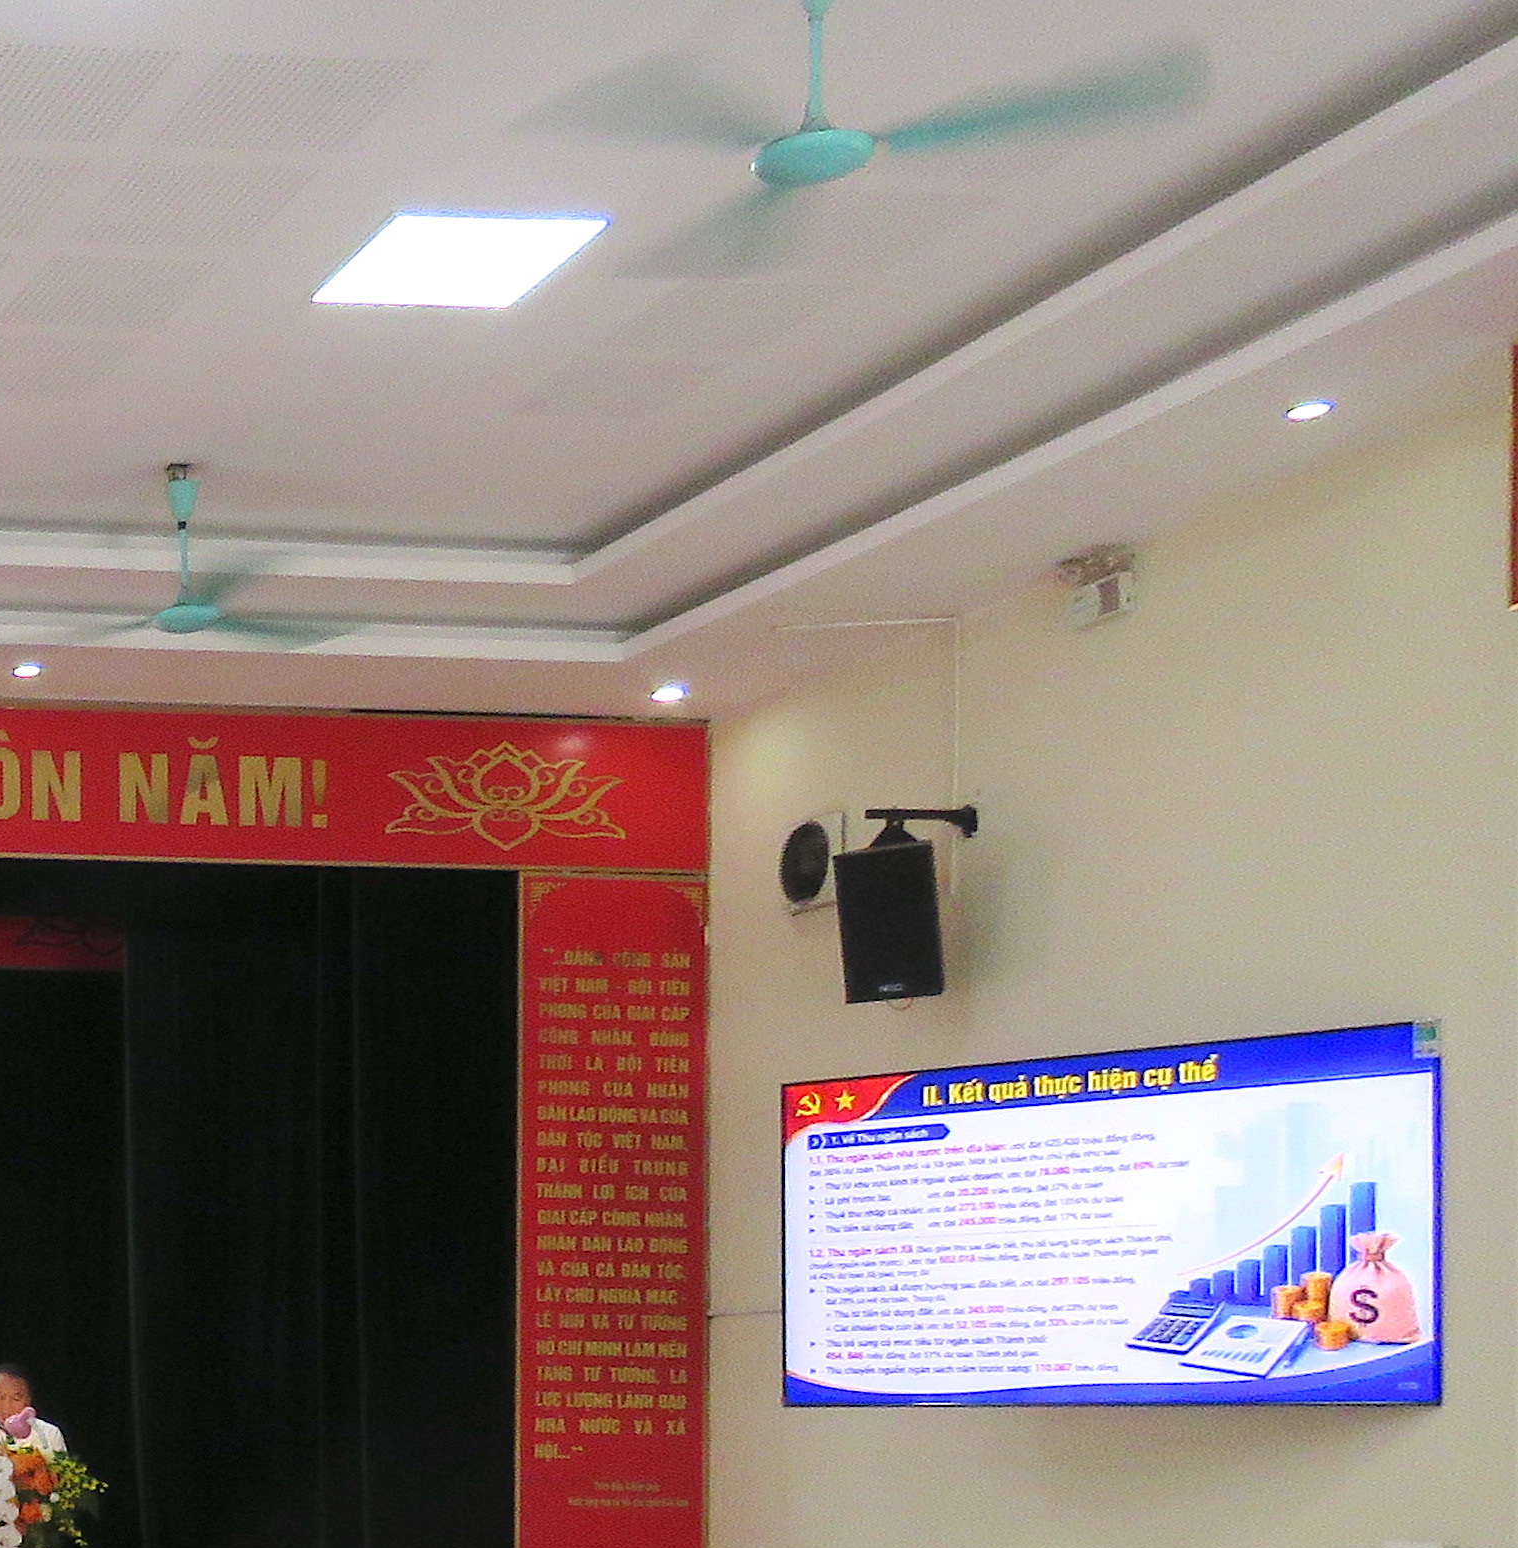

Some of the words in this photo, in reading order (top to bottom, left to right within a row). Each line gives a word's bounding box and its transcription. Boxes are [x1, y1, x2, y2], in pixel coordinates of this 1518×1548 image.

[118, 735, 328, 829] NĂM!
[922, 1085, 943, 1107] II.
[948, 1079, 985, 1105] Kết
[989, 1075, 1029, 1103] quả
[1034, 1075, 1082, 1099] thực
[1088, 1068, 1139, 1095] hiện
[1143, 1068, 1172, 1090] cụ
[1179, 1054, 1220, 1083] thể
